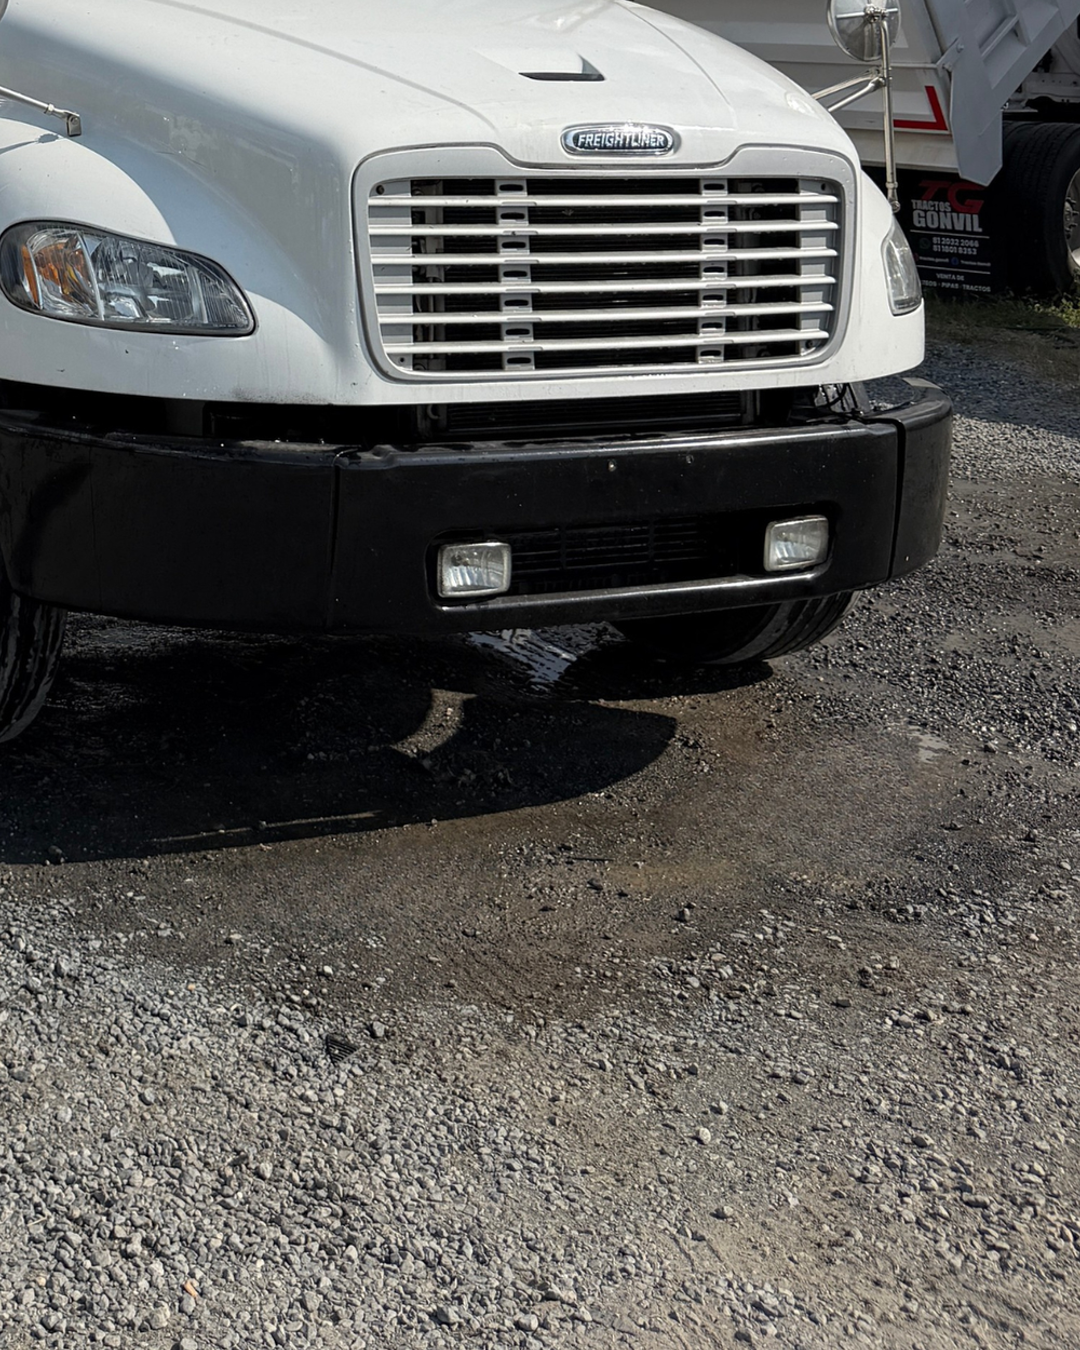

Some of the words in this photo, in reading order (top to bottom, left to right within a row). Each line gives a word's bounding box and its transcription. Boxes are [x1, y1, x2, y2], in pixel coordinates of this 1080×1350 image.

[578, 132, 664, 147] FREIGHTLINER
[911, 199, 951, 211] TRACTOS
[913, 210, 982, 232] GONVIL
